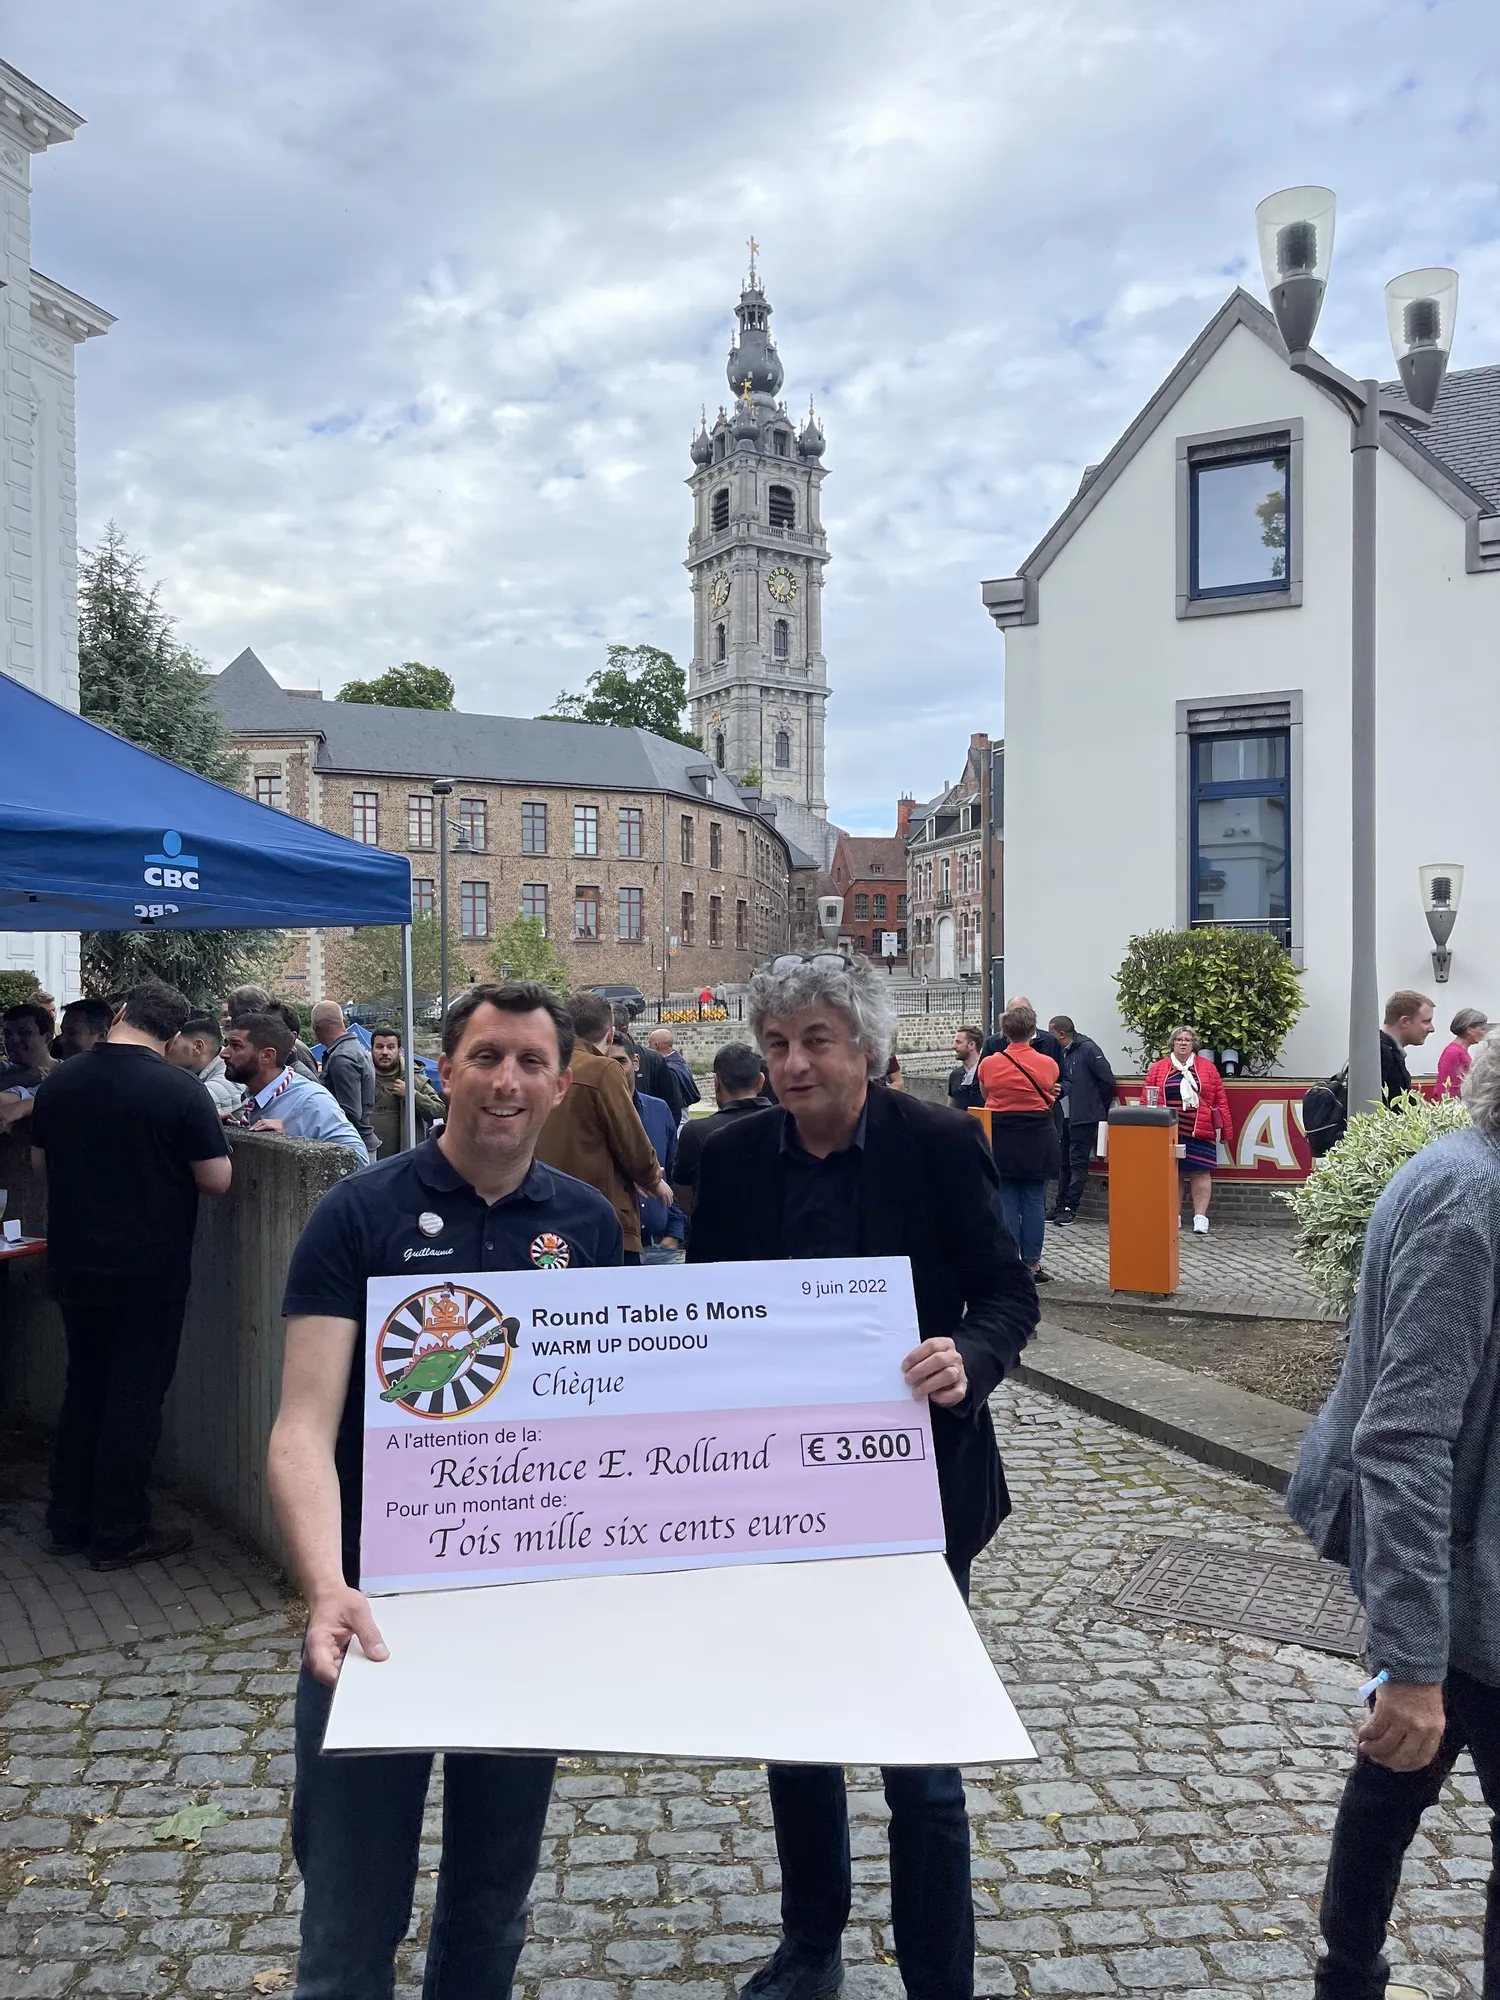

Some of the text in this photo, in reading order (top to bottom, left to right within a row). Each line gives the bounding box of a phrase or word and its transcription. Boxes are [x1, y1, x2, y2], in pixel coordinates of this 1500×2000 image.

[144, 867, 199, 890] CBC
[403, 1247, 454, 1263] Guillaume
[802, 1279, 888, 1299] 9 juin 2022
[532, 1302, 768, 1328] Round Table 6 Mons
[532, 1335, 709, 1356] WARM UP DOUDOU
[532, 1366, 625, 1407] Chèque
[386, 1427, 542, 1450] A l'attention de la:
[807, 1434, 912, 1463] € 3.600
[431, 1433, 777, 1490] Résidence E. Rolland
[386, 1492, 567, 1518] Pour un montant de:
[429, 1508, 827, 1559] Tois mille six cents euros
